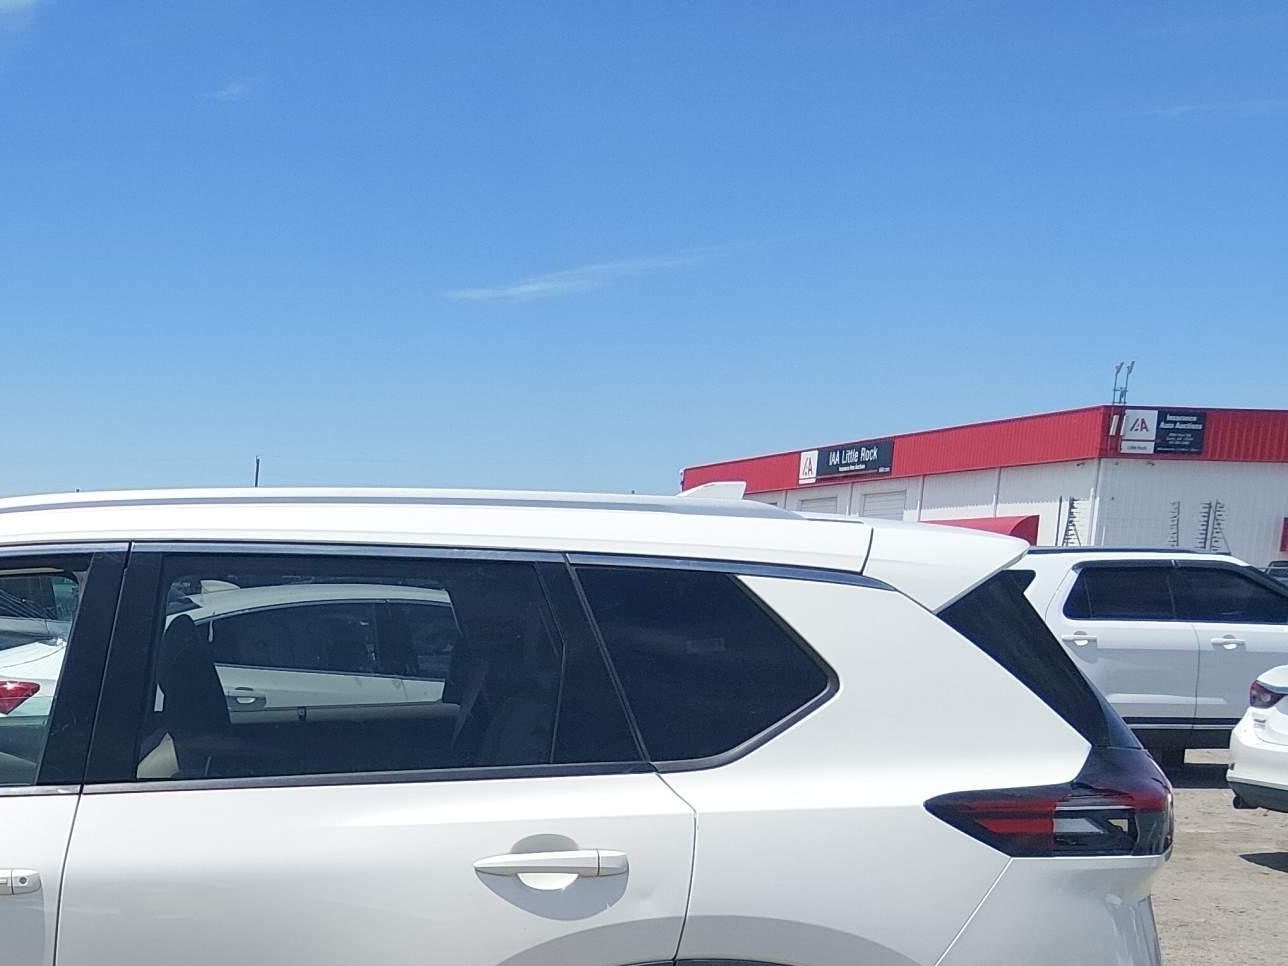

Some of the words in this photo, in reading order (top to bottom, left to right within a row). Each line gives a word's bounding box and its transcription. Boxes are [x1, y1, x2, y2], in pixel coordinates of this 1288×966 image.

[828, 450, 840, 466] IAA
[841, 448, 859, 464] Little
[860, 446, 878, 461] Rock
